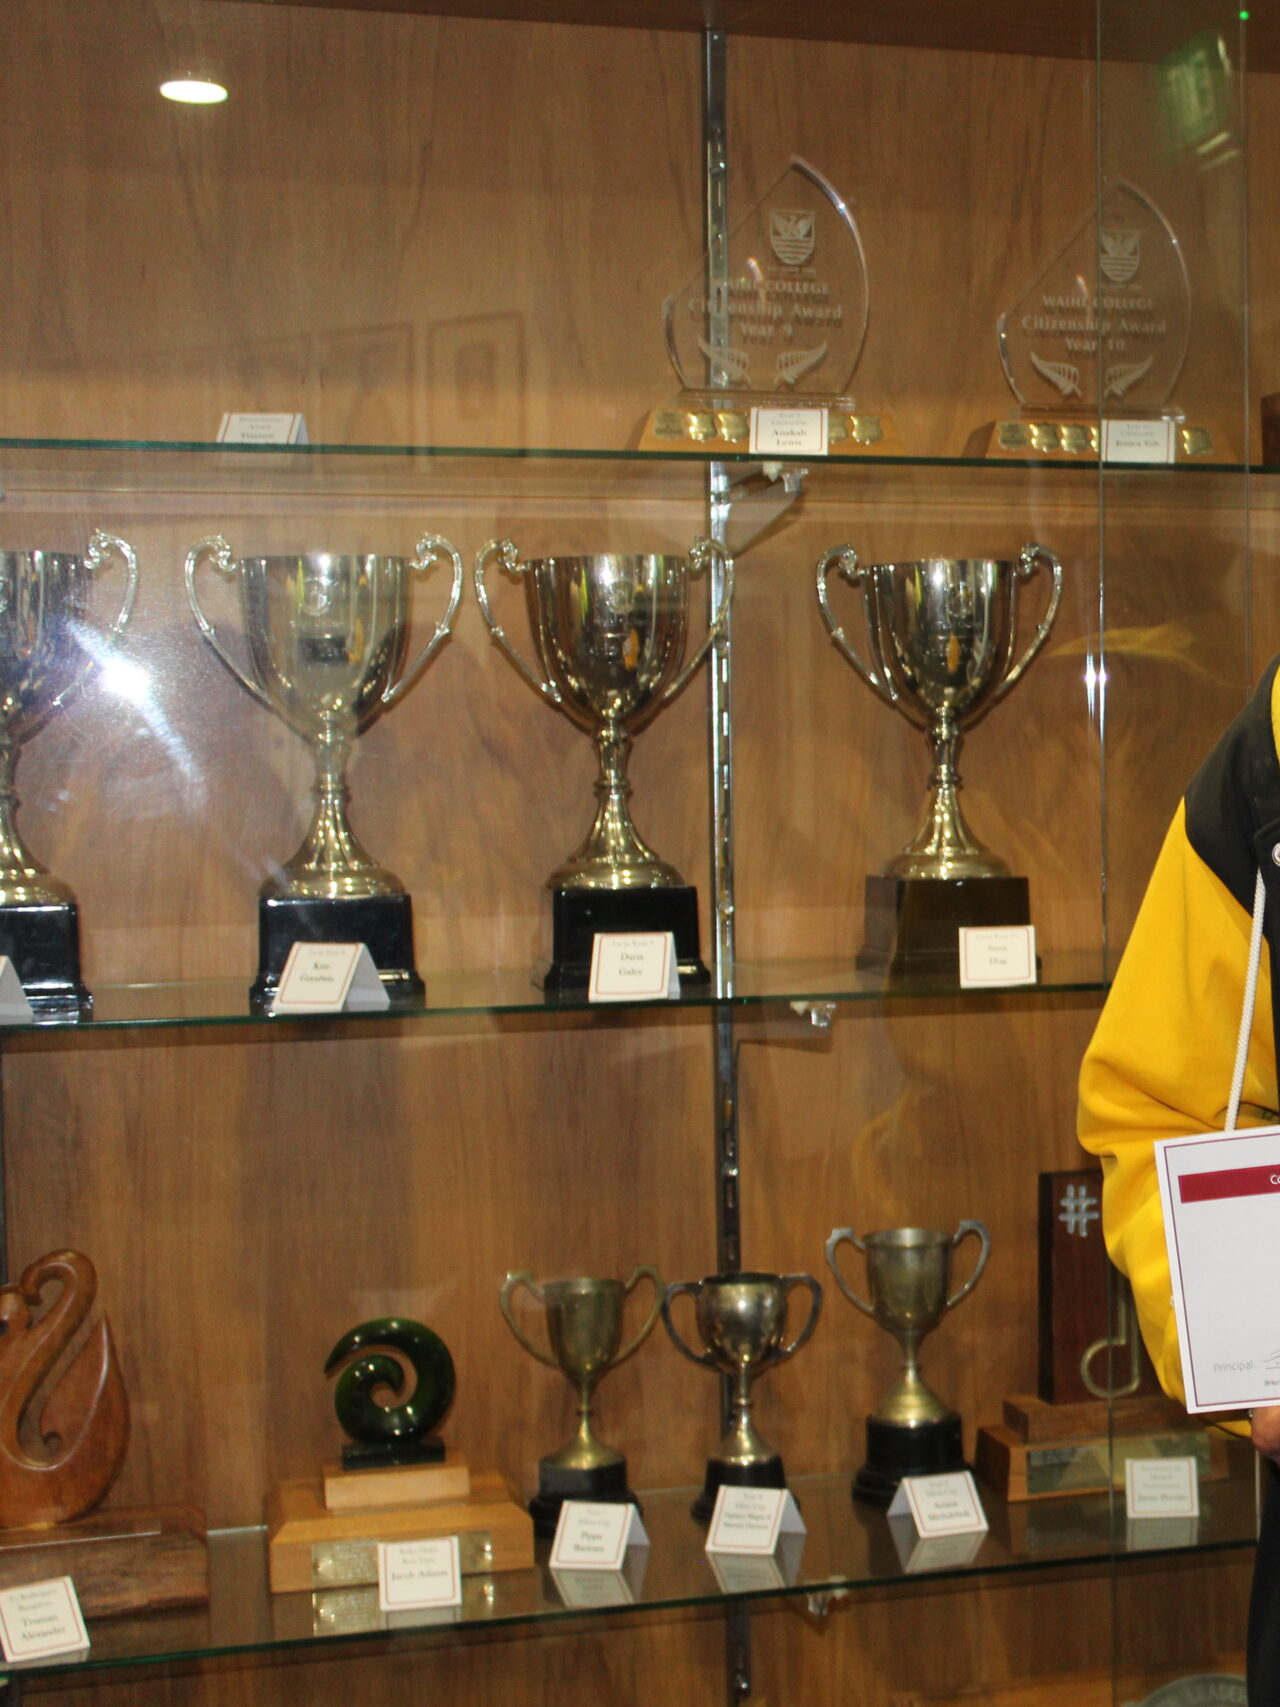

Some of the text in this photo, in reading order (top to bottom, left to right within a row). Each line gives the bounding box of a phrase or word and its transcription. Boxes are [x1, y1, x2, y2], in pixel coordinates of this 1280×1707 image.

[765, 280, 830, 294] COLLEGE
[688, 297, 843, 320] Cienship Award
[739, 322, 793, 336] Year 9
[1021, 316, 1167, 335] Citizenship Award
[1065, 337, 1098, 351] Year
